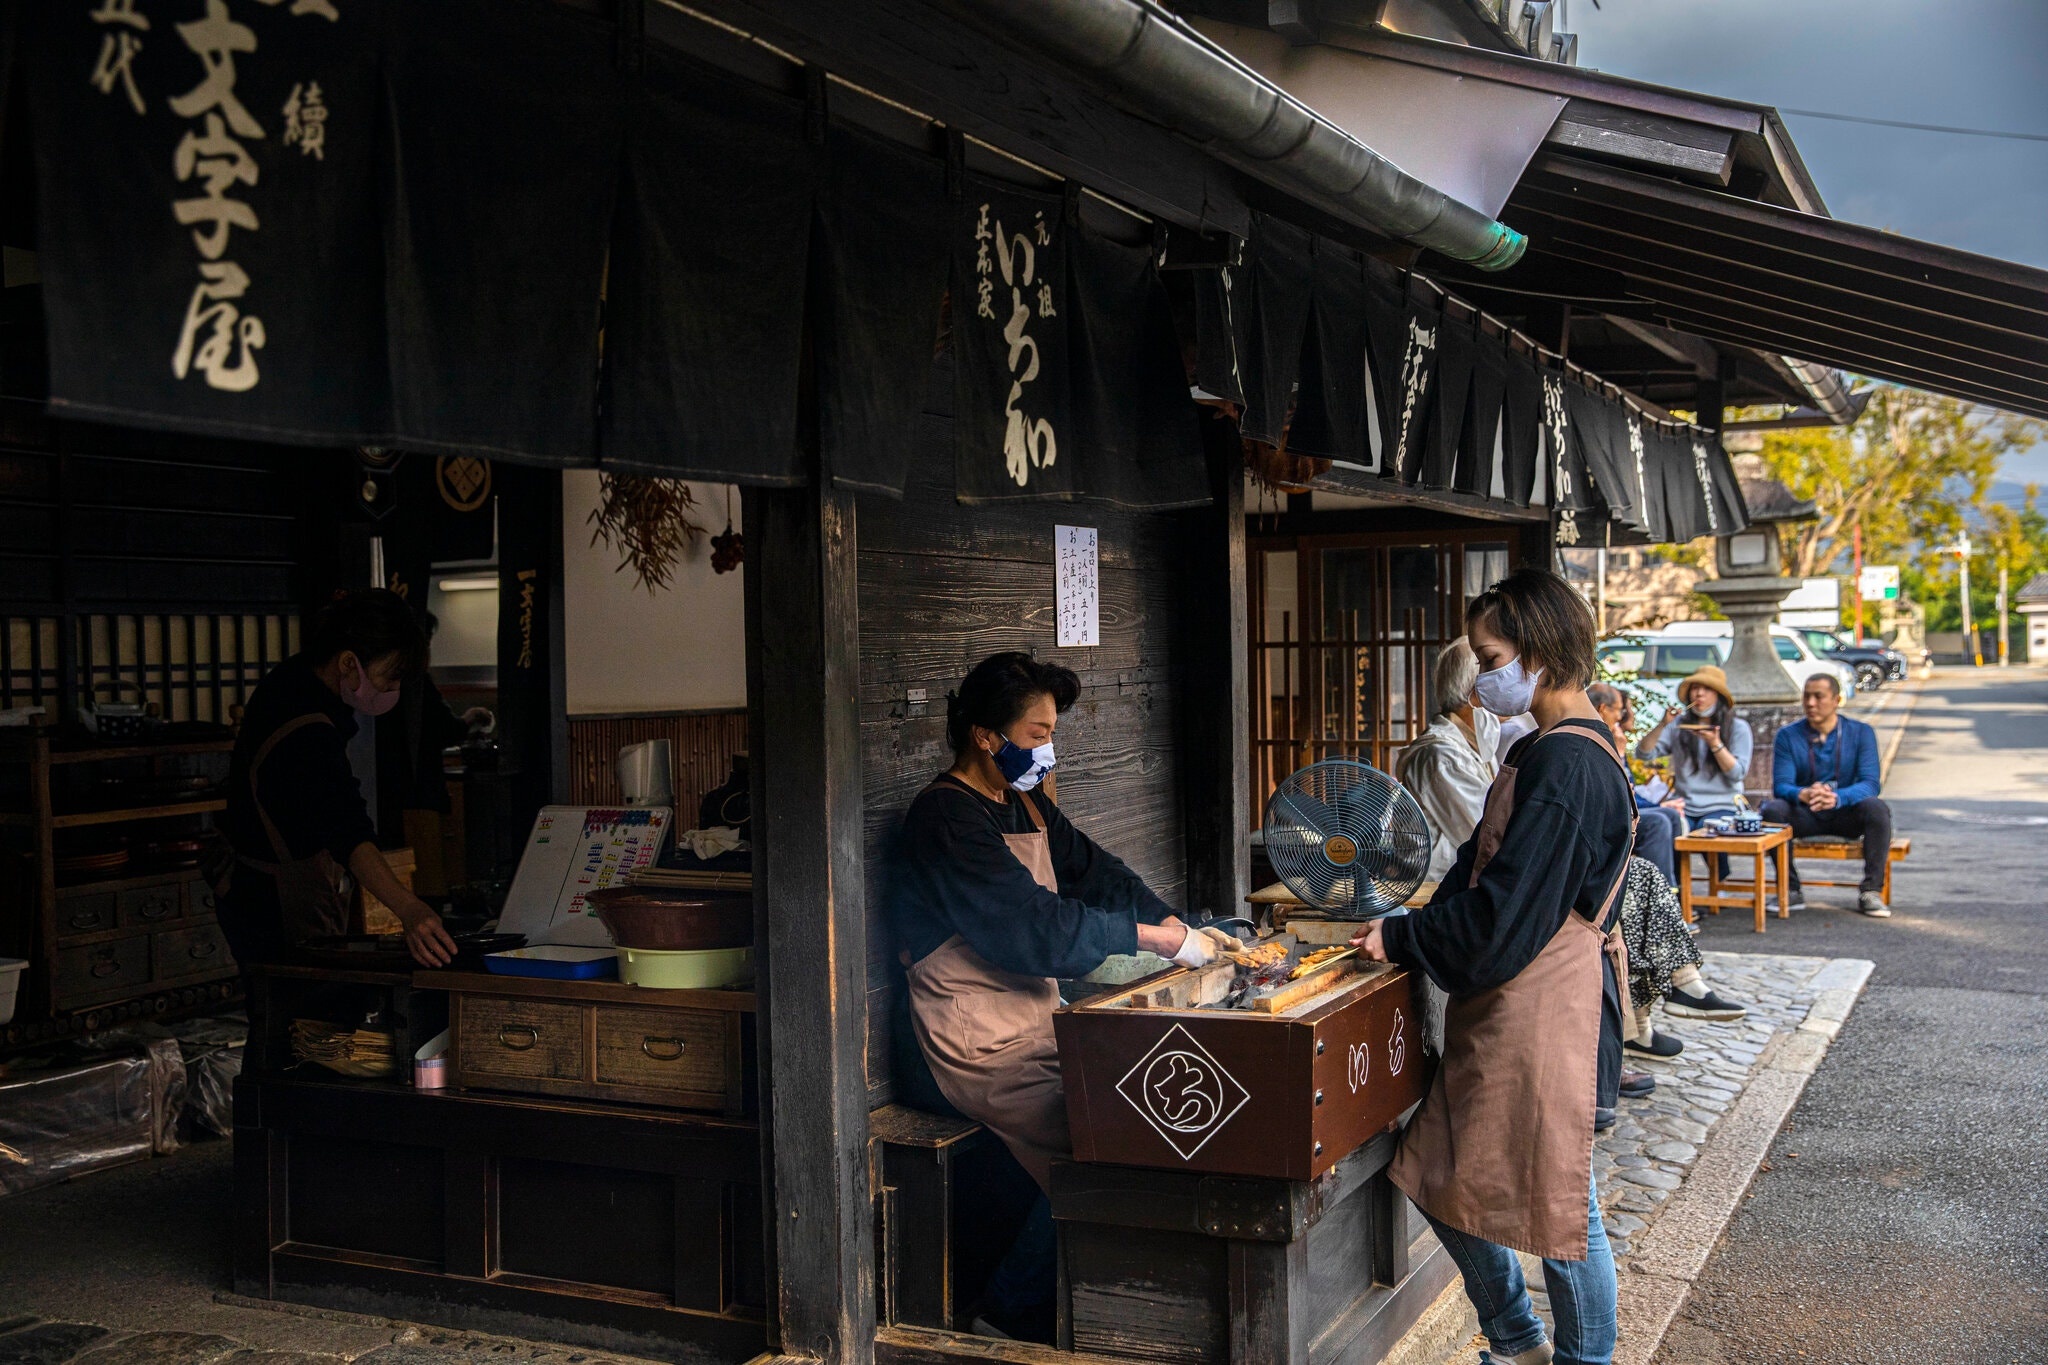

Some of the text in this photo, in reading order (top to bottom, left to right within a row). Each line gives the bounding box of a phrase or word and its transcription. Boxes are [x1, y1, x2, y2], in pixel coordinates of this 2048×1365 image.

[169, 0, 287, 392] 文字屋
[1034, 210, 1056, 319] 元祖
